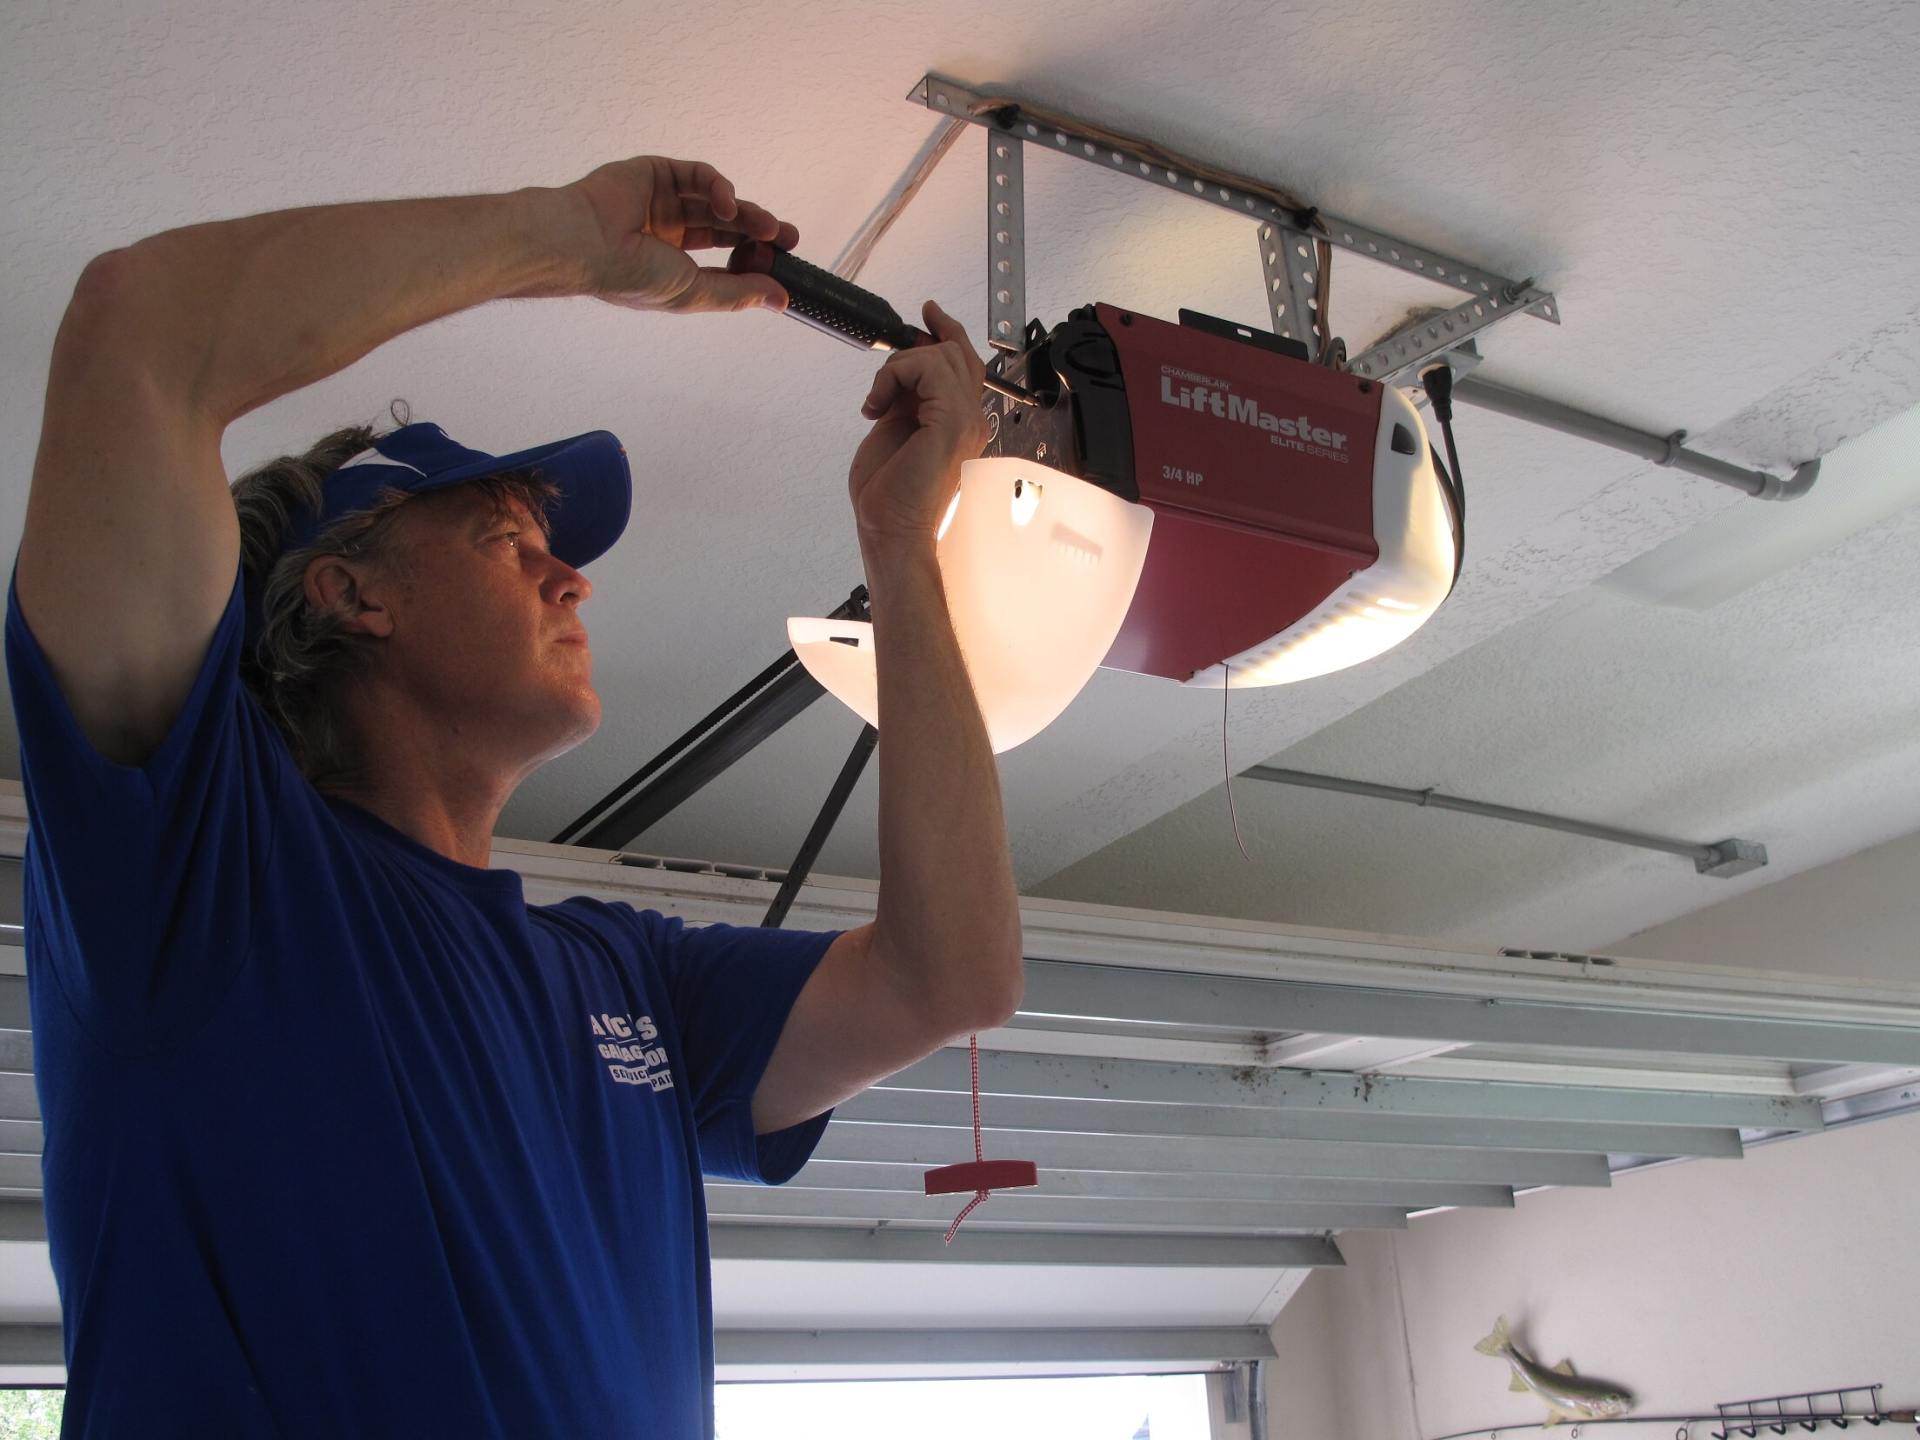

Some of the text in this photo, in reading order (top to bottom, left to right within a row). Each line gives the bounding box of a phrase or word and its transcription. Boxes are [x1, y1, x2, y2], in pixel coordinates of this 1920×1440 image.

[1161, 365, 1229, 390] CHAMBERLAIN
[1161, 376, 1348, 449] LiftMaster
[1271, 435, 1349, 463] ELITE SERIES
[1162, 465, 1203, 485] 3/4 HP
